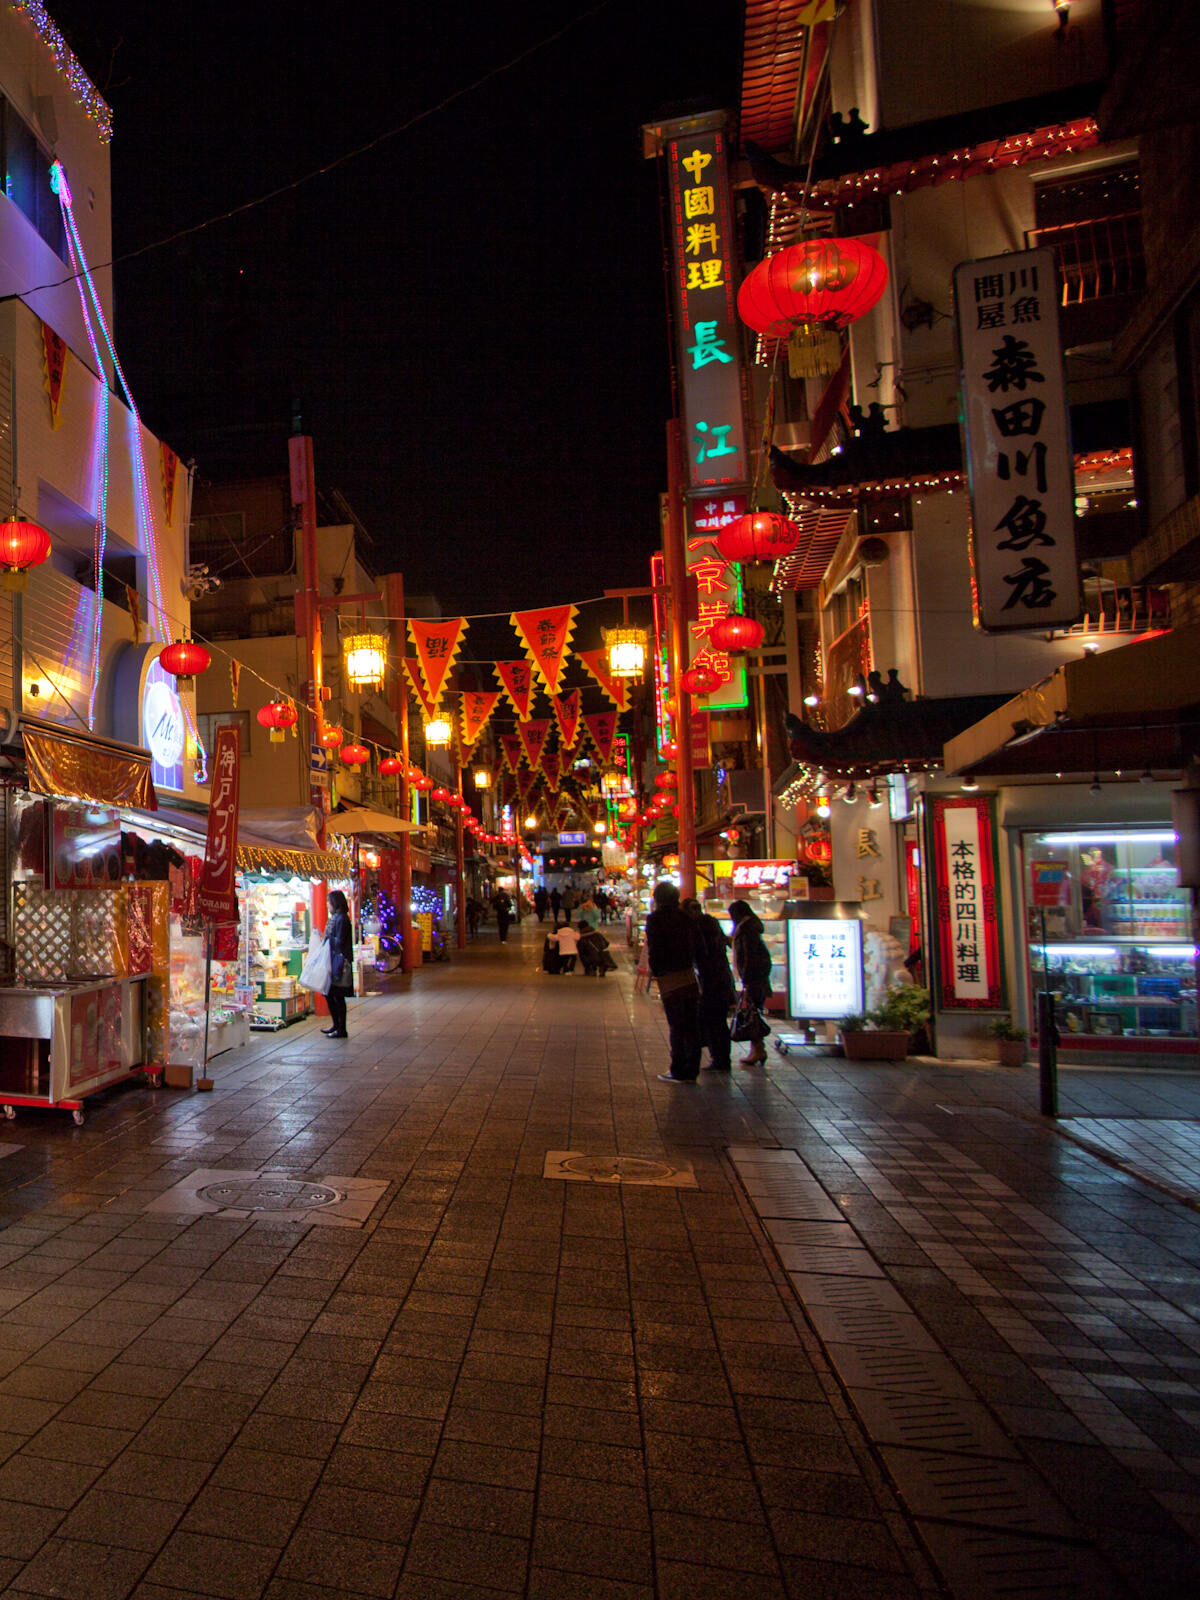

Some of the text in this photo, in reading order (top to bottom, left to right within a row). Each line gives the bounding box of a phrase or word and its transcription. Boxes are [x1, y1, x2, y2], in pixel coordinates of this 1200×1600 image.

[681, 149, 725, 290] 中國料理
[974, 272, 1006, 331] 問屋
[1009, 266, 1041, 325] 川魚
[686, 320, 739, 464] 長江
[982, 335, 1058, 610] 森田川魚店
[211, 744, 236, 877] 神戸プリン
[855, 828, 883, 901] 長江
[951, 839, 981, 984] 本格的四川料理
